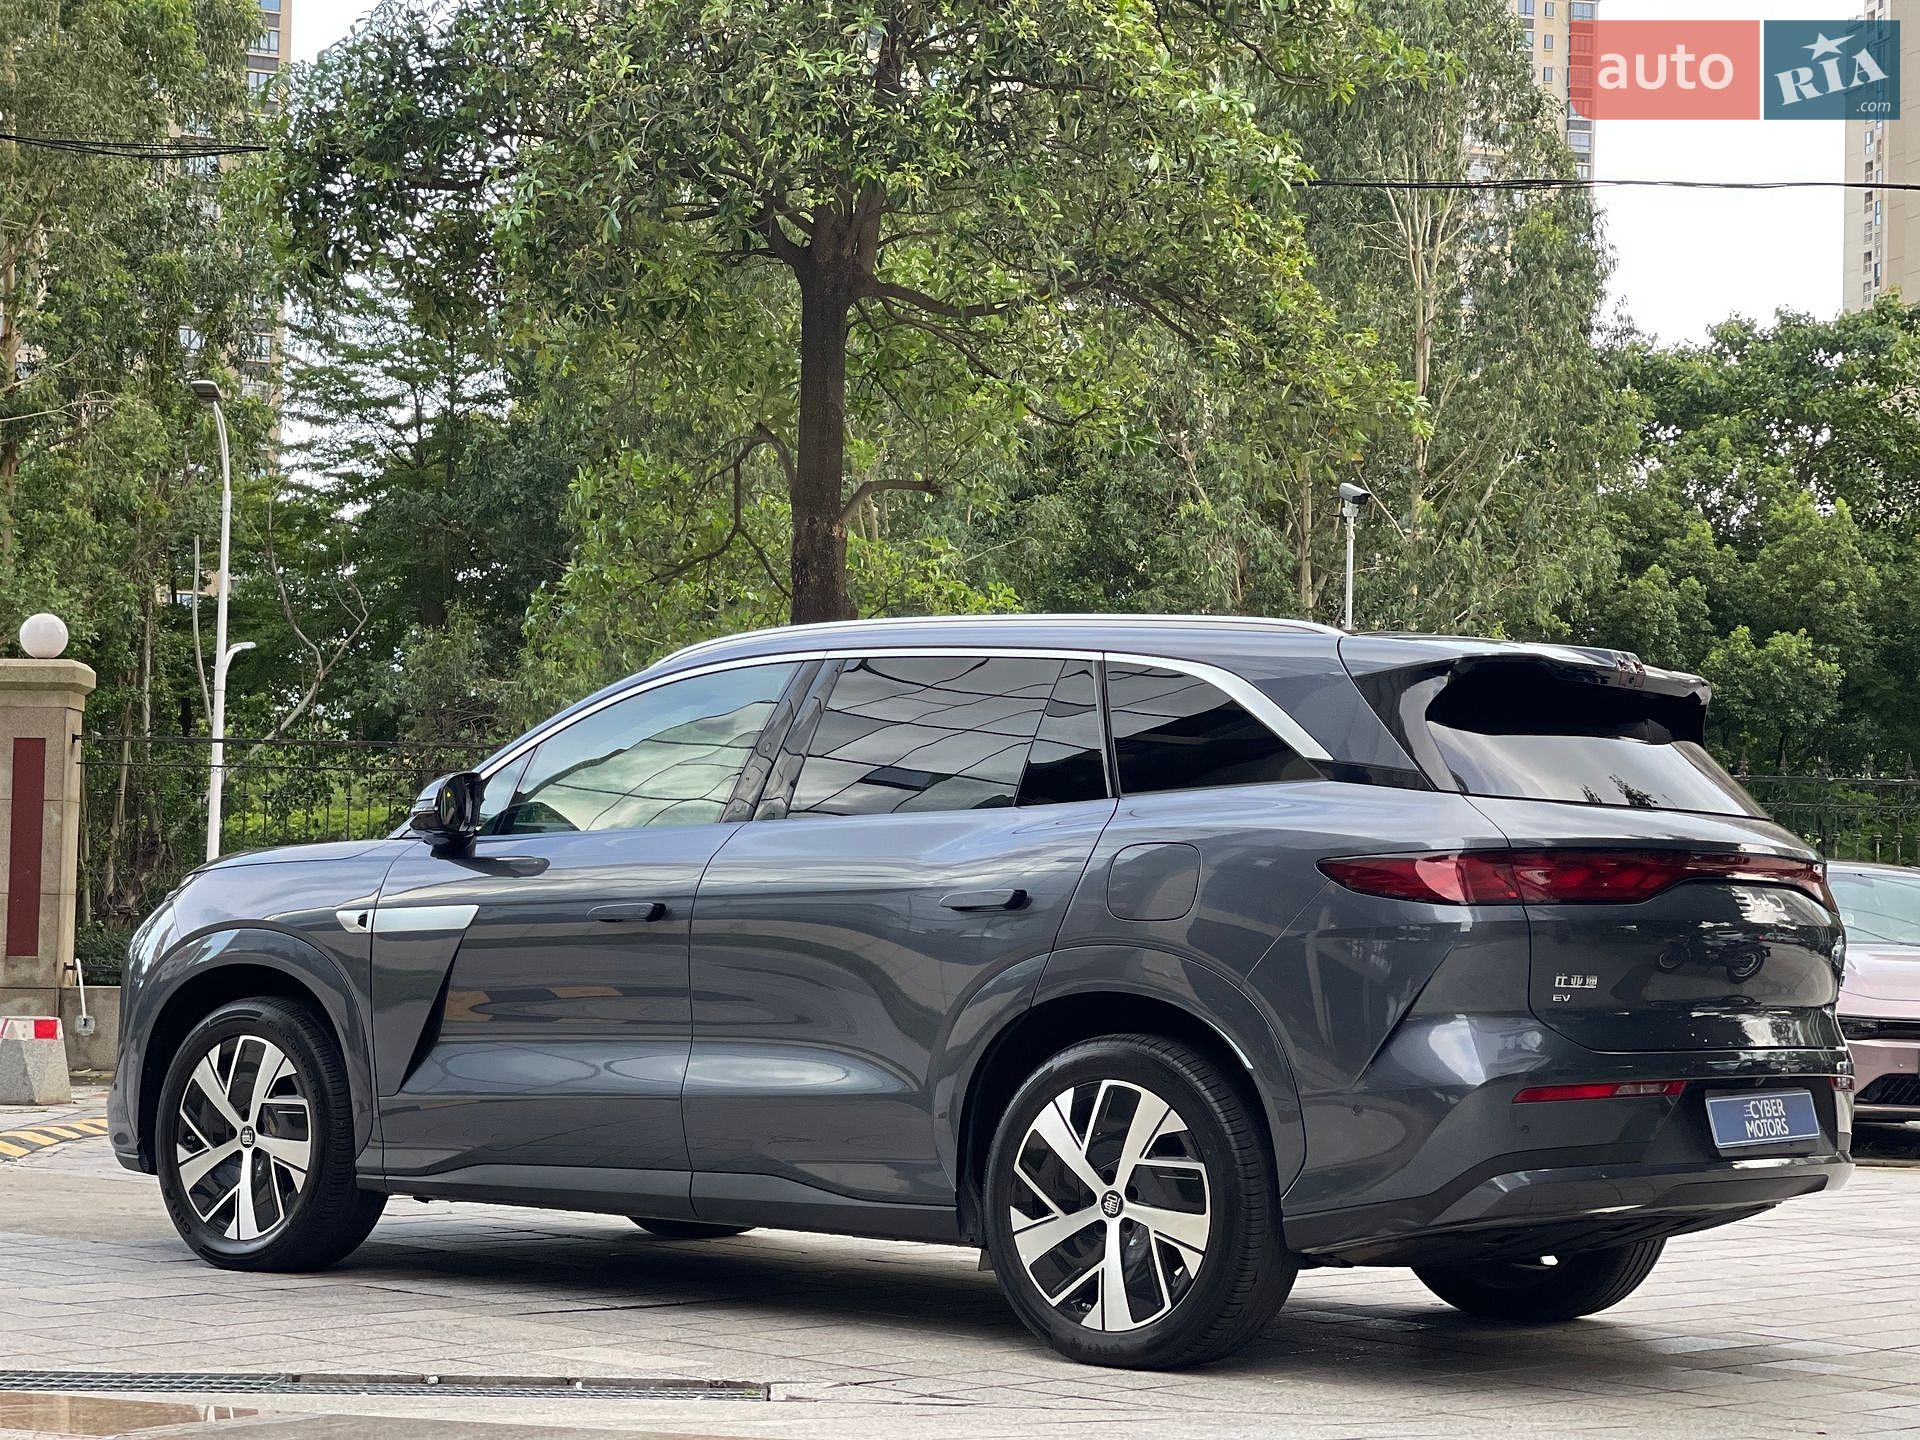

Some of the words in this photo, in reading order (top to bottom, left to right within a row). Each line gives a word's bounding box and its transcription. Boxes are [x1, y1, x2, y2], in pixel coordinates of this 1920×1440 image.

[1552, 994, 1571, 1002] EV
[1748, 1098, 1787, 1119] CYBER
[1745, 1117, 1790, 1138] MOTORS
